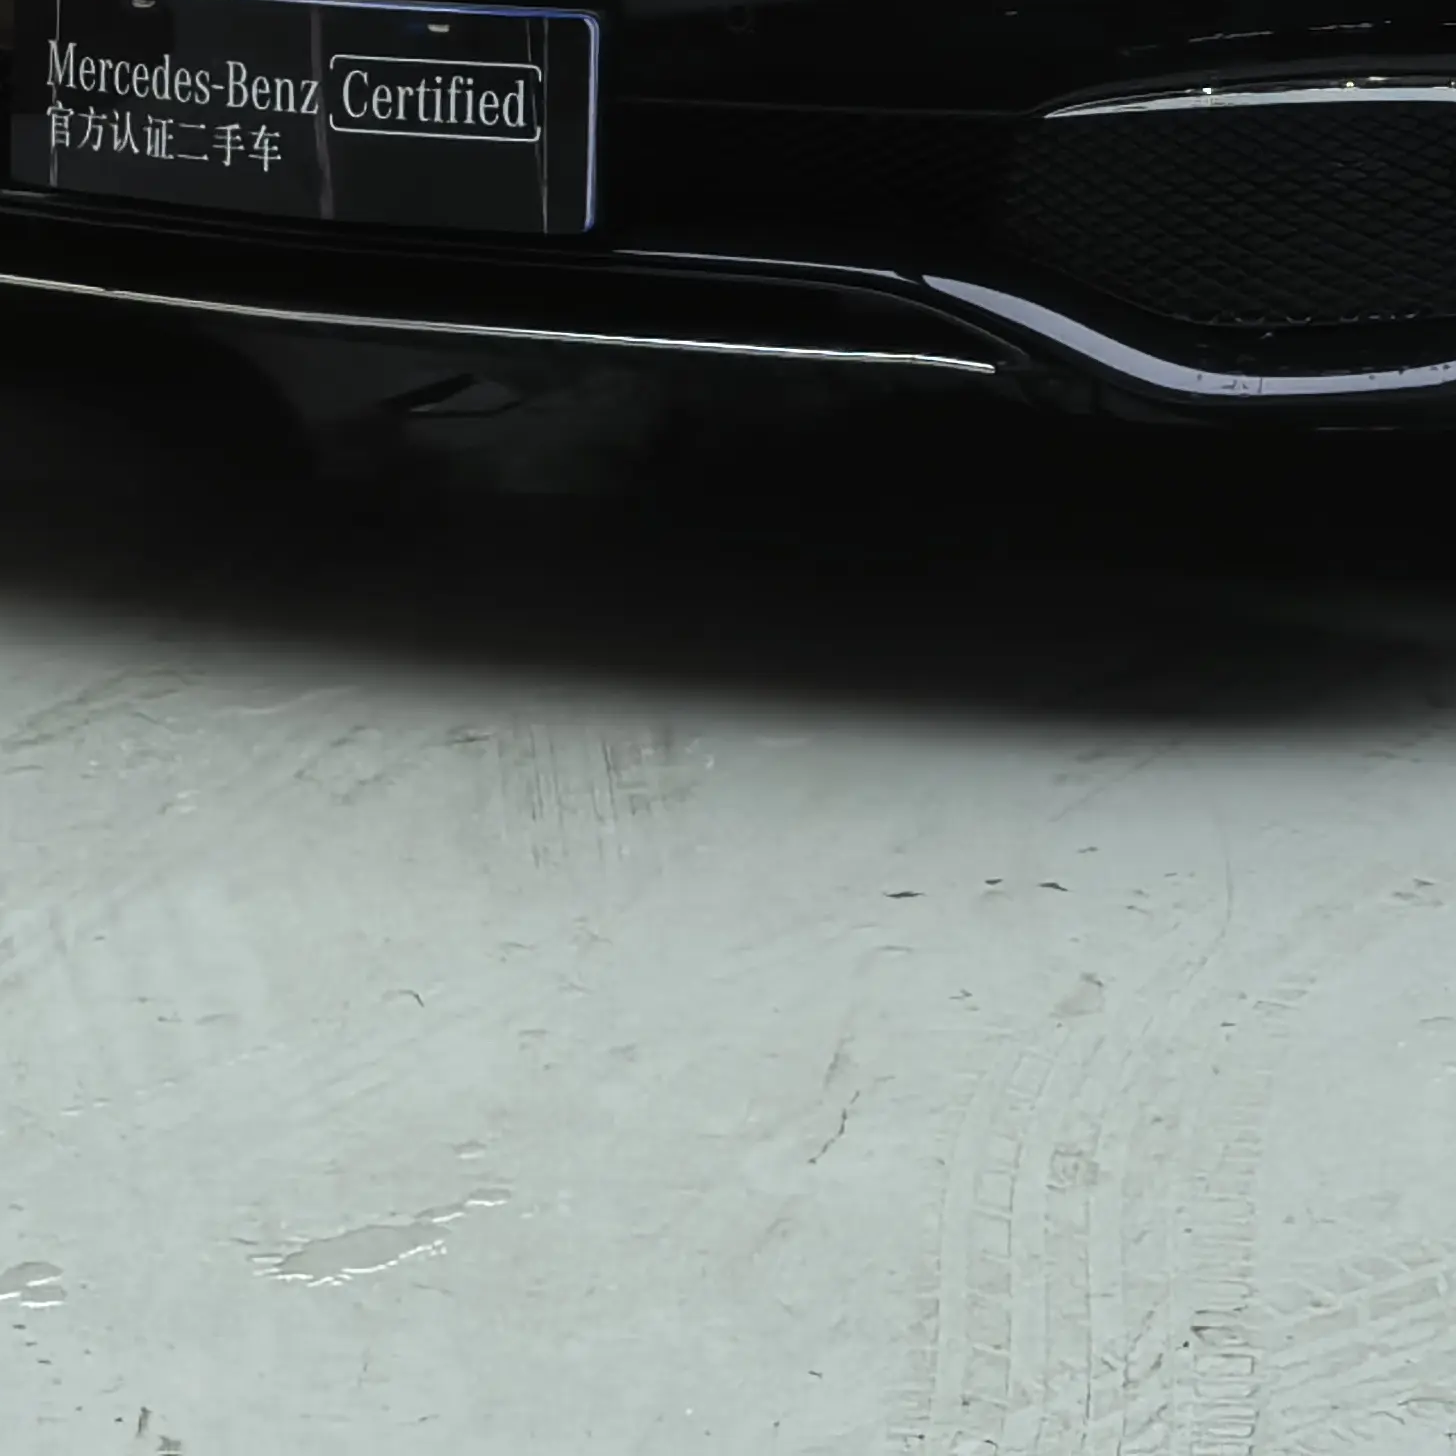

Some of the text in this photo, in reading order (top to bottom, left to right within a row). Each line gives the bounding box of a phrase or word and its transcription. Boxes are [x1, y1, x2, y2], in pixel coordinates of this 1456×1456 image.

[46, 40, 528, 128] Mercedes-Benz Certified
[46, 100, 282, 172] 官方认证二手车
